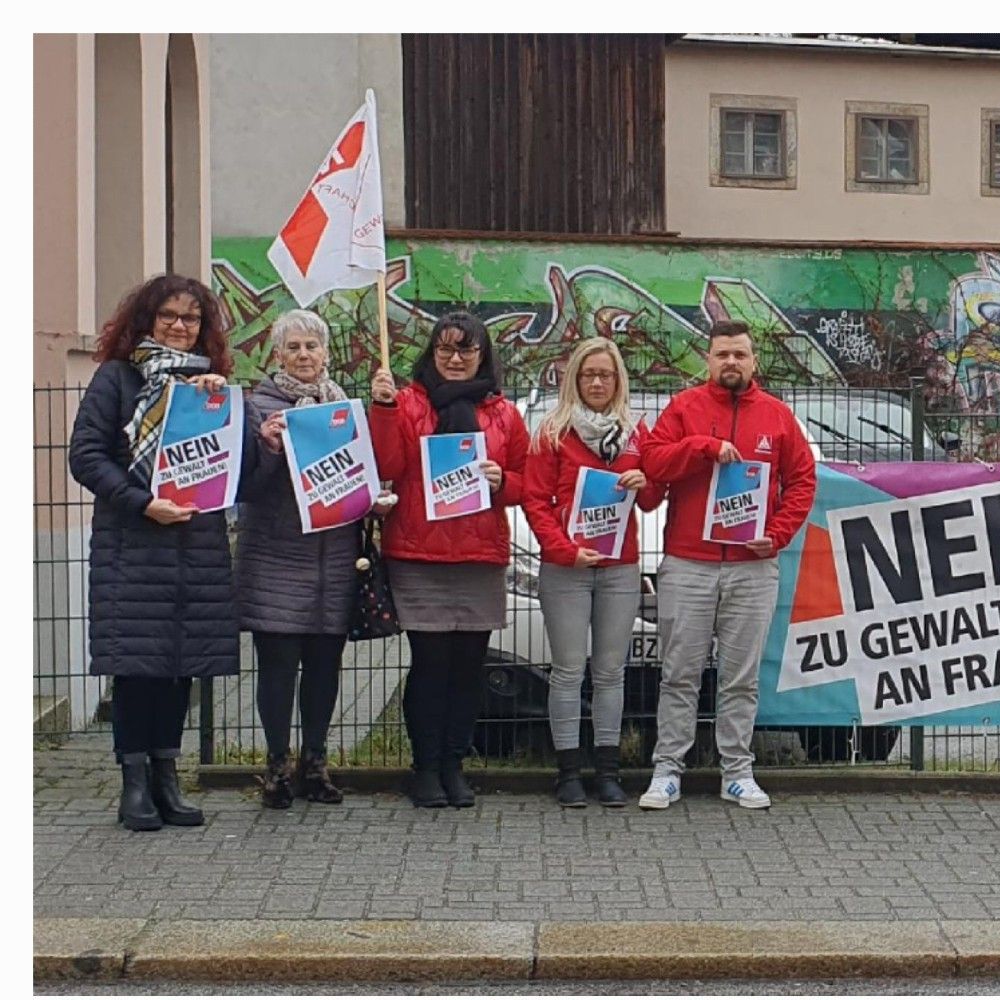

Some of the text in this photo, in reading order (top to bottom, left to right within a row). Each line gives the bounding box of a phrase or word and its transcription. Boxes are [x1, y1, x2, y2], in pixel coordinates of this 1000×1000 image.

[165, 433, 220, 467] NEIN
[306, 448, 354, 487] NEIN
[436, 466, 473, 491] NEIN
[583, 505, 617, 523] NEIN
[719, 492, 754, 512] NEIN
[796, 629, 849, 673] ZU
[873, 663, 932, 710] AN
